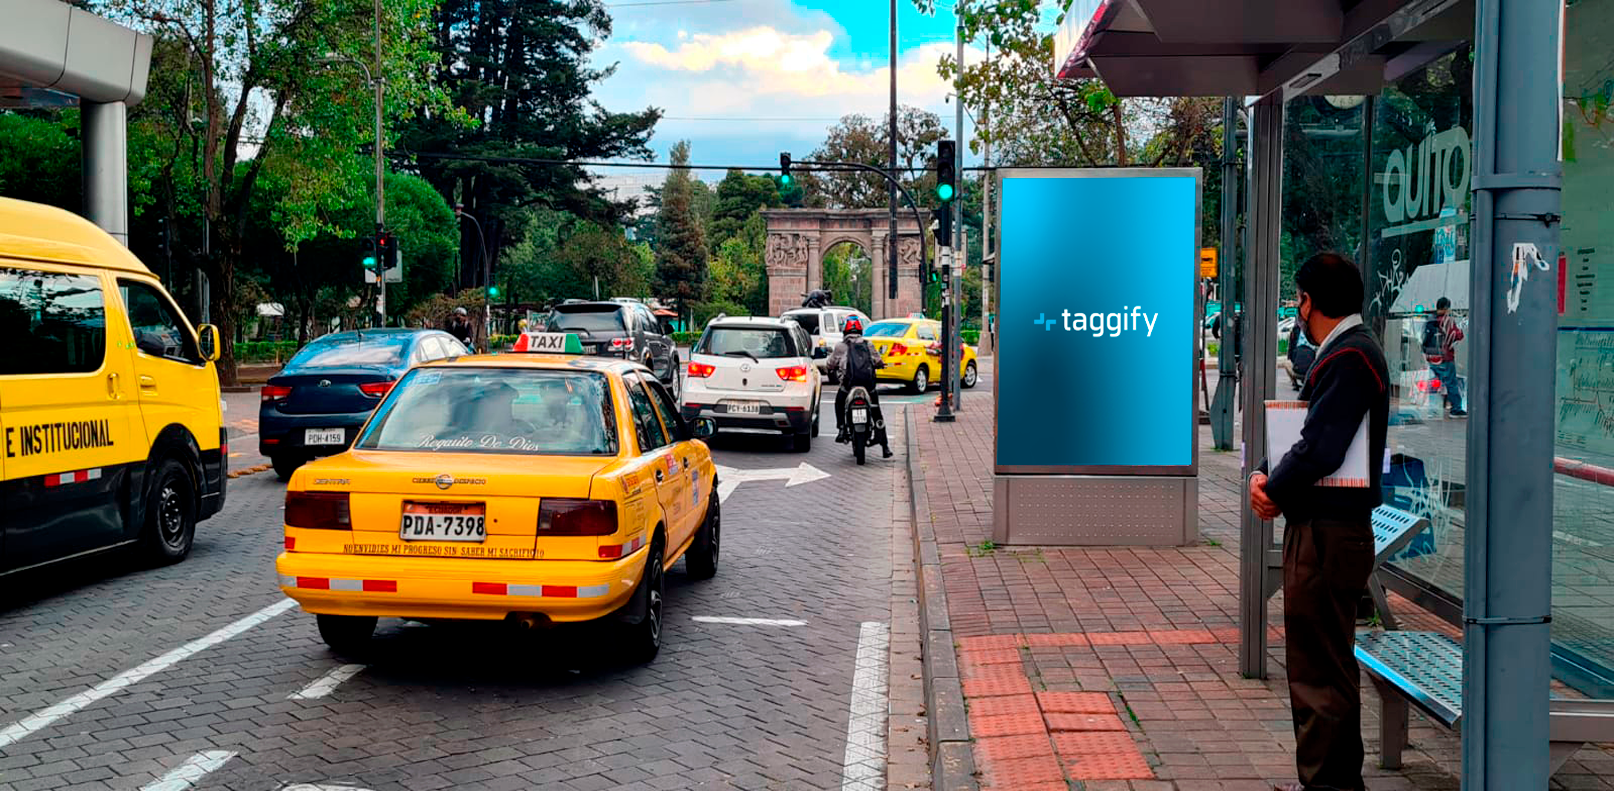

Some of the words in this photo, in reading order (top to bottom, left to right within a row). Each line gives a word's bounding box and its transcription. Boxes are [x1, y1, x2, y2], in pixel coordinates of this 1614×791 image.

[1061, 305, 1158, 337] taggify
[530, 335, 564, 349] TAXI
[6, 426, 15, 458] E
[20, 419, 114, 457] INSTITUCIONAL
[403, 515, 485, 536] PDA-7398
[391, 545, 402, 554] MI
[404, 545, 442, 555] PROGRESO
[444, 546, 457, 555] SIN
[461, 547, 485, 556] SABER
